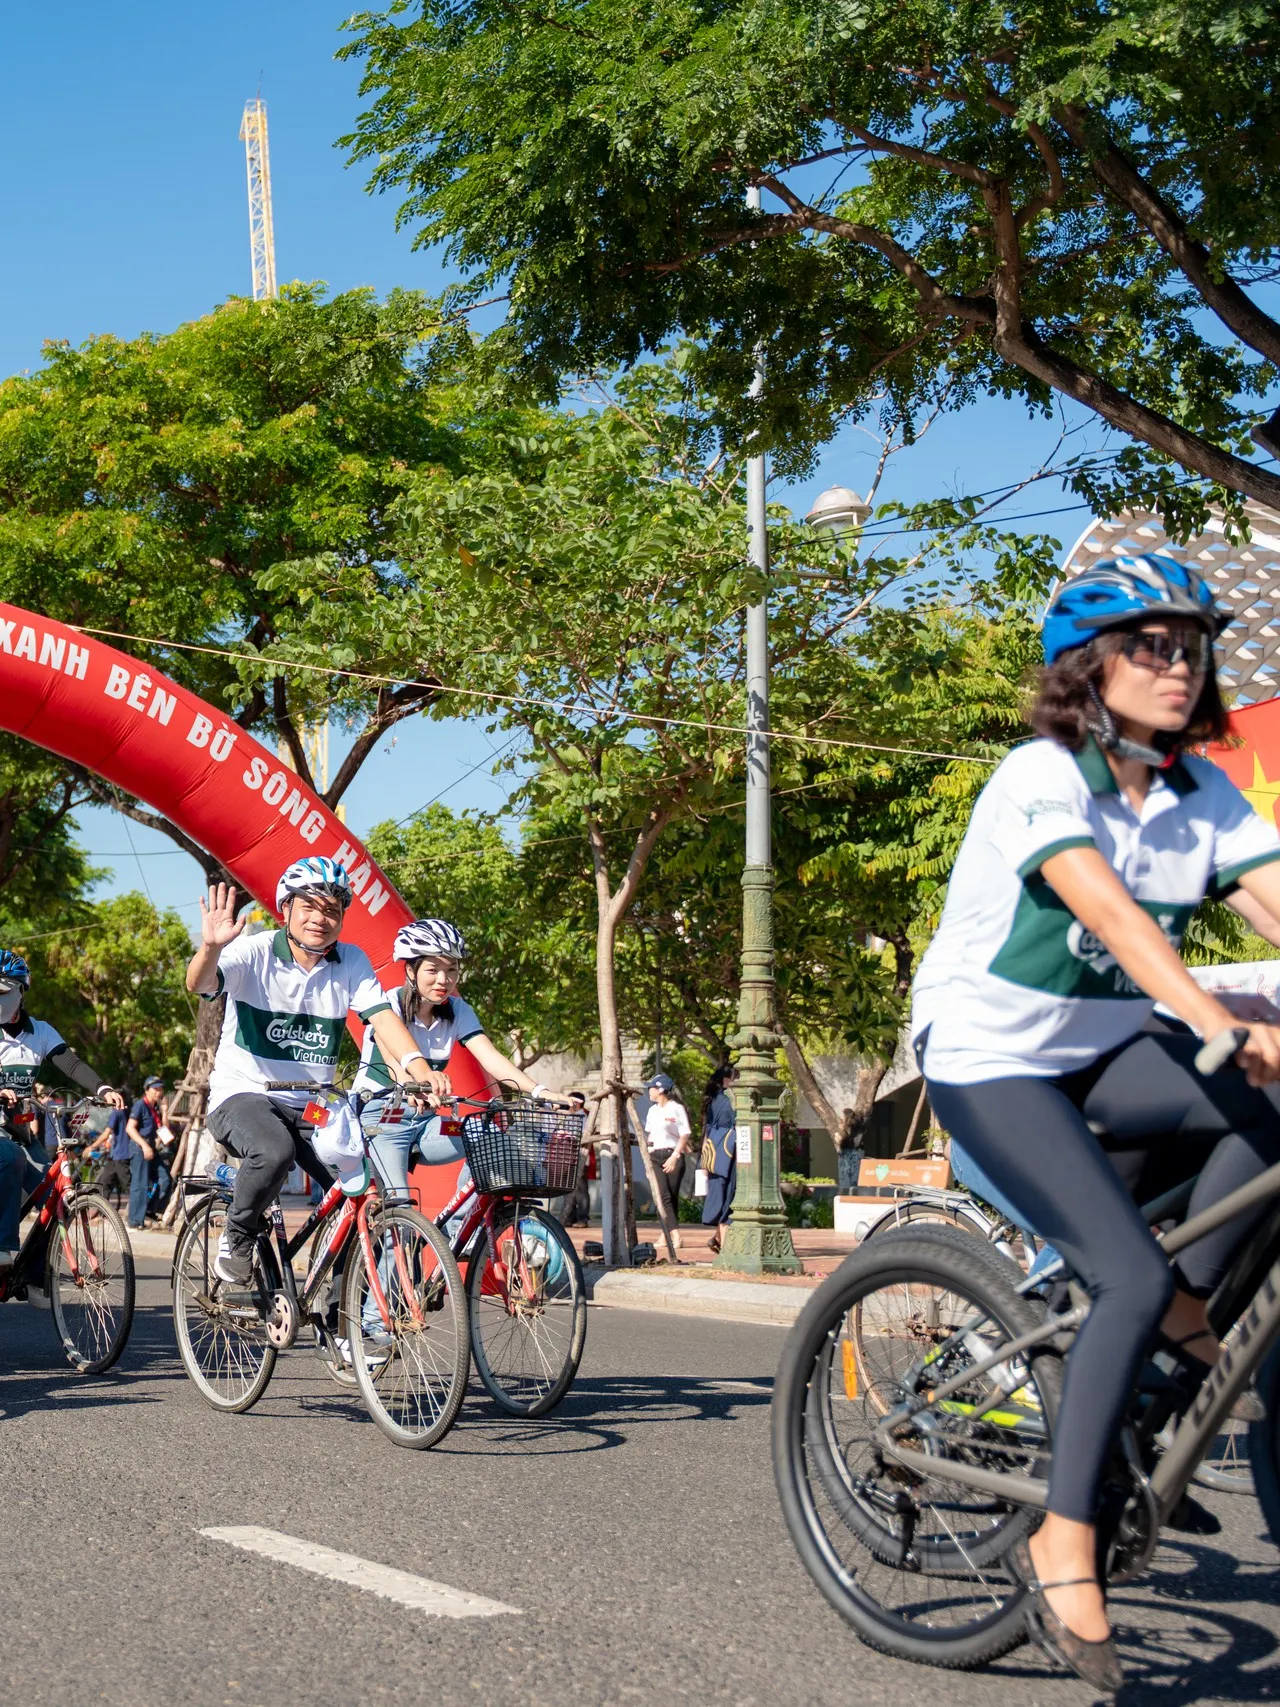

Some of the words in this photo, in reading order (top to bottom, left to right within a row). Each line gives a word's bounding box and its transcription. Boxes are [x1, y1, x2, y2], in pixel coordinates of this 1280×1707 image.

[104, 664, 177, 726] BÊN
[186, 712, 238, 762] BỜ
[242, 757, 326, 845] SÔNG
[331, 839, 391, 917] HÀN
[266, 1019, 330, 1049] Carlsberg
[293, 1048, 338, 1065] Vietnam
[438, 1193, 461, 1220] SPORT
